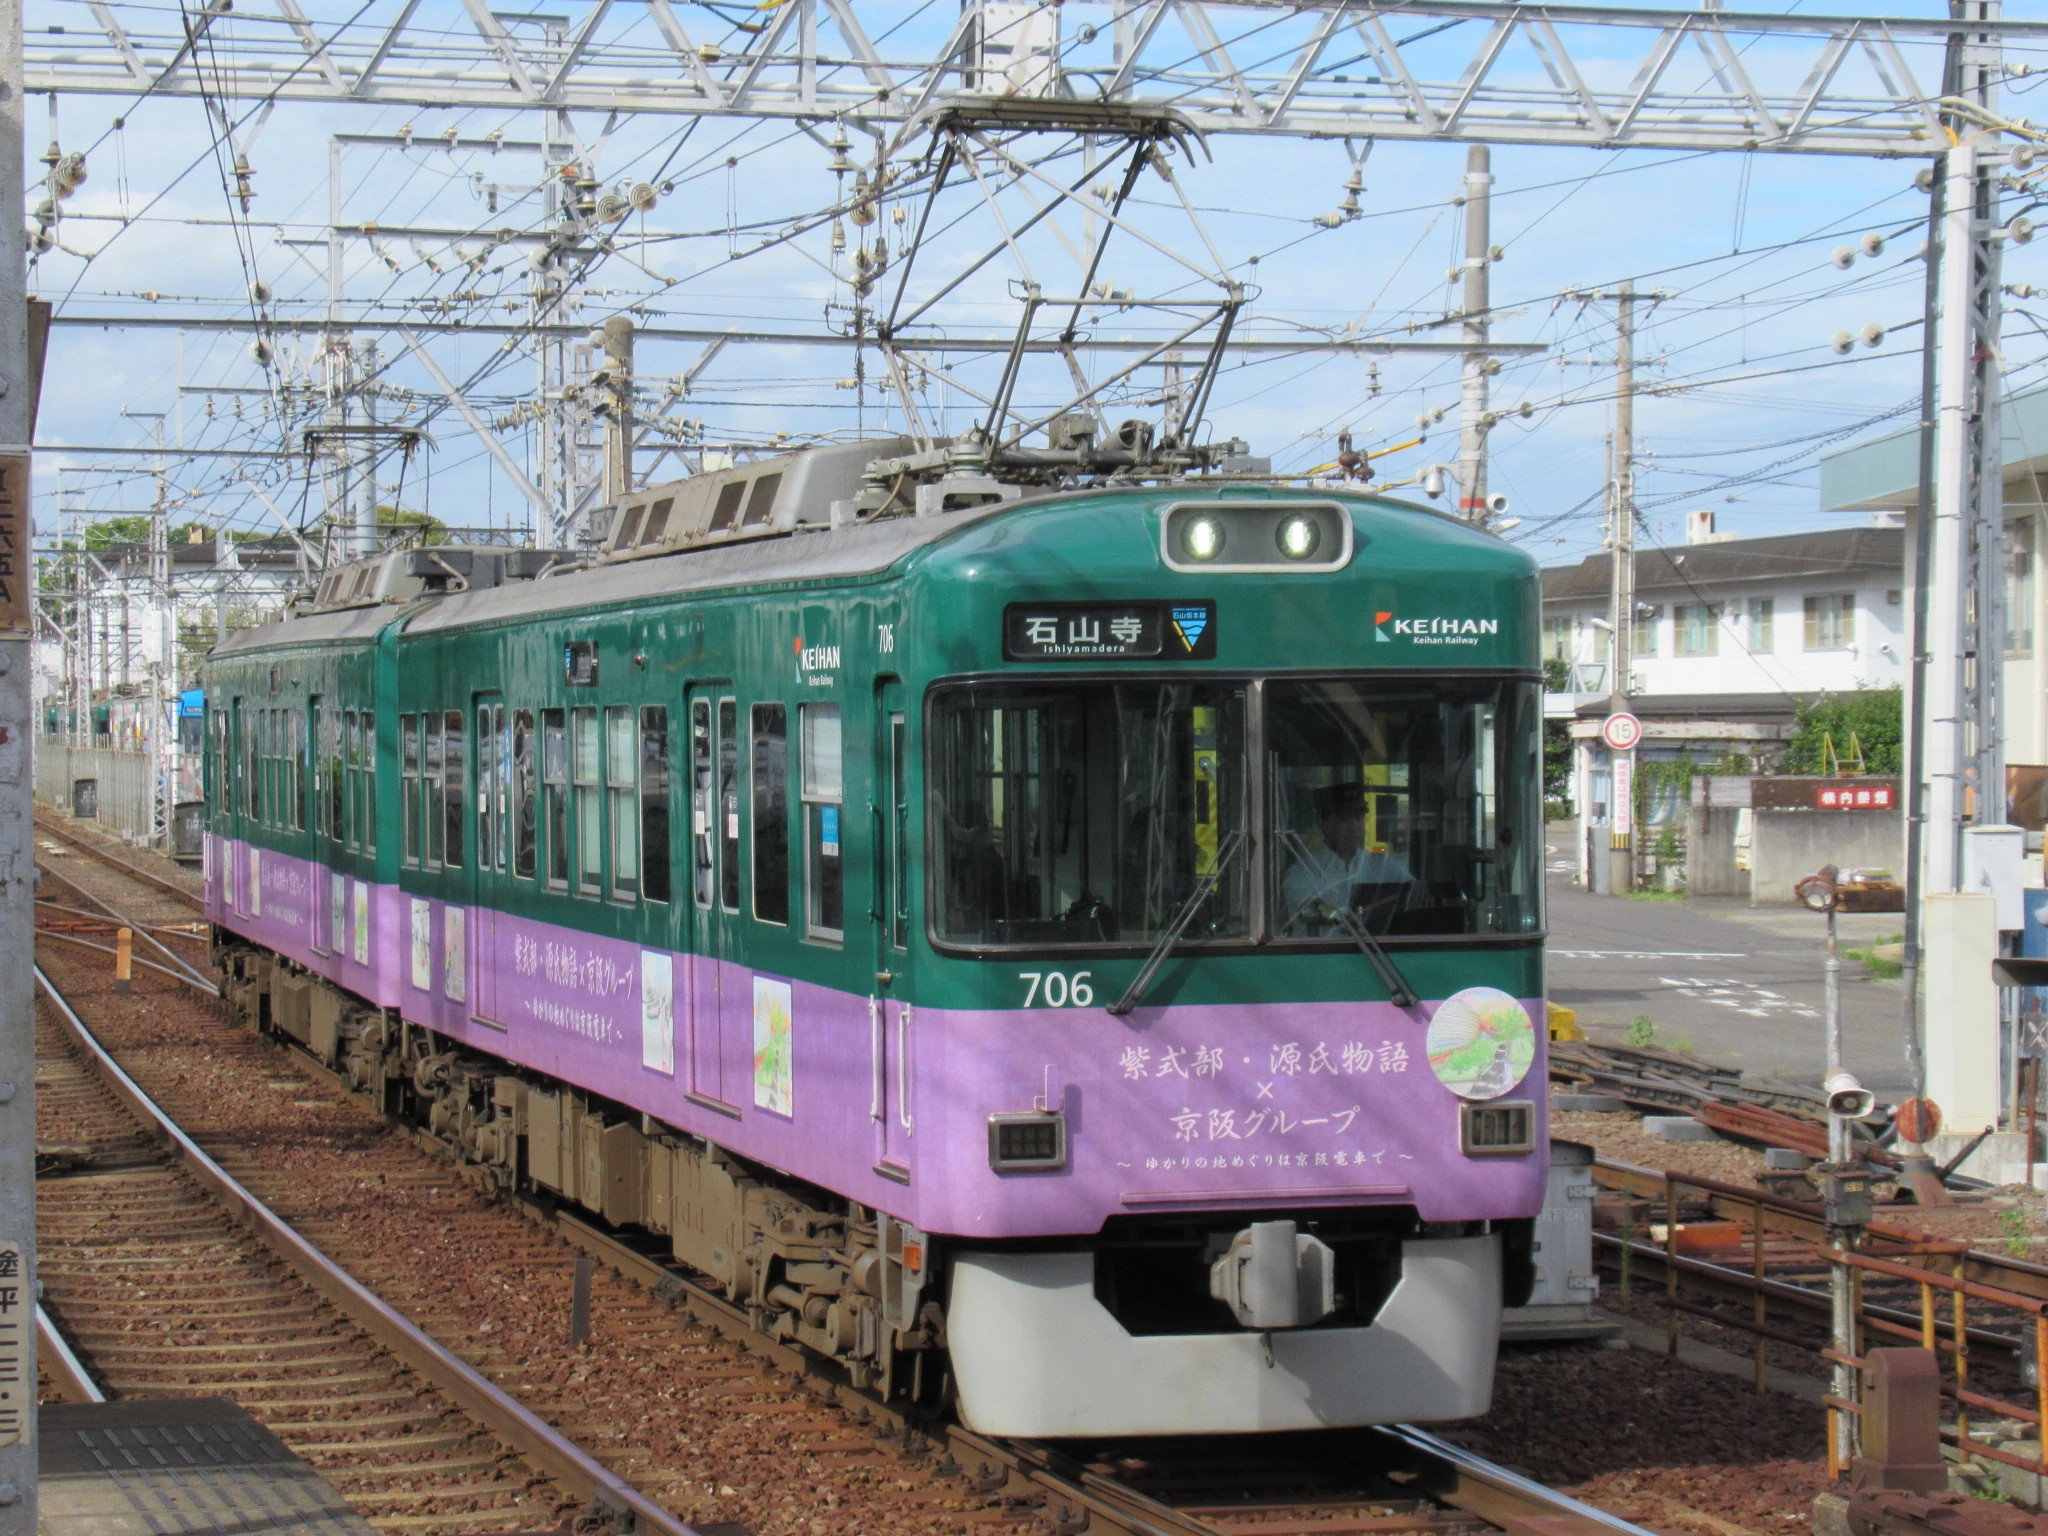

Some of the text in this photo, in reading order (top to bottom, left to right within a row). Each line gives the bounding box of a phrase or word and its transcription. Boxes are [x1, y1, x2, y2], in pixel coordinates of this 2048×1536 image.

[878, 624, 894, 653] 706
[1026, 616, 1142, 643] 石山寺
[1395, 617, 1498, 634] KEIHAN
[1044, 644, 1125, 654] Ishiyamadera
[1413, 636, 1479, 645] Keihan Railway
[802, 644, 840, 670] KEIHAN
[1614, 724, 1632, 739] 15
[1019, 971, 1093, 1008] 706
[1170, 1105, 1361, 1142] 京阪グループ
